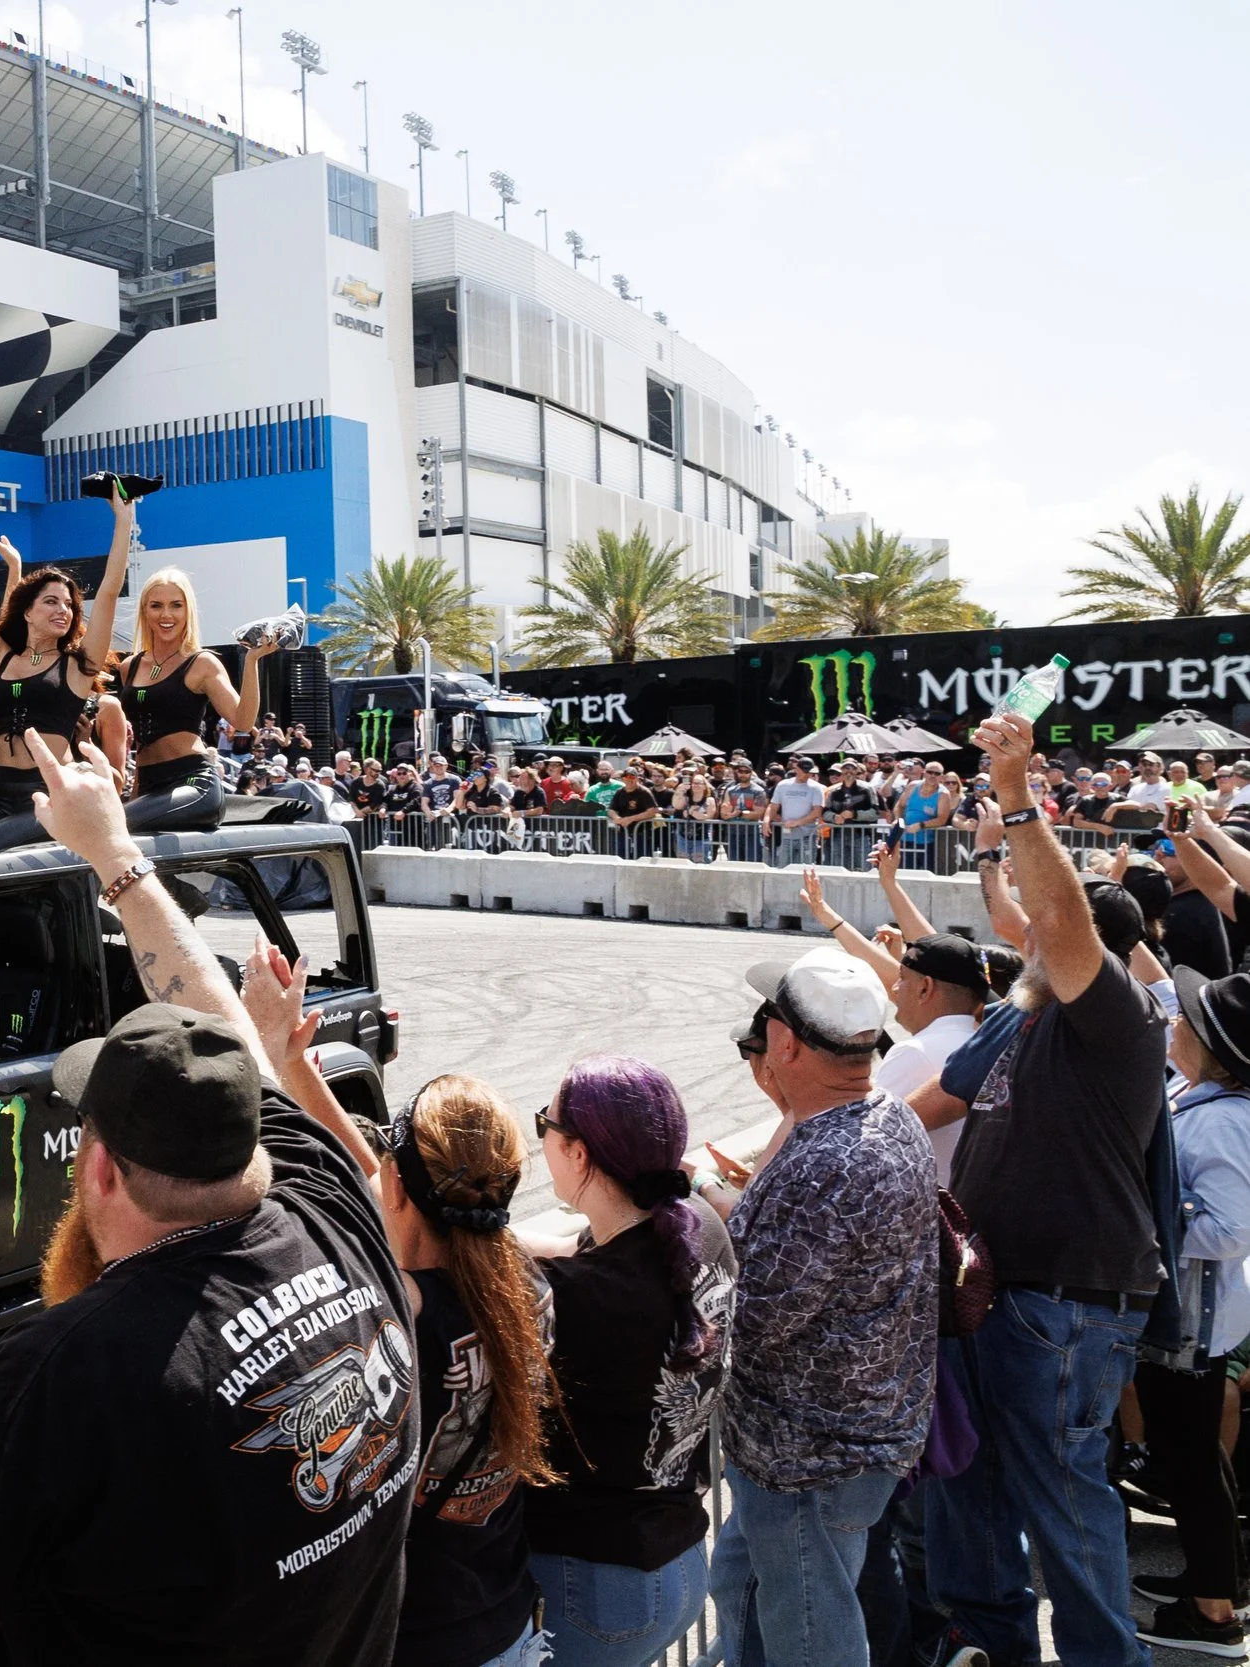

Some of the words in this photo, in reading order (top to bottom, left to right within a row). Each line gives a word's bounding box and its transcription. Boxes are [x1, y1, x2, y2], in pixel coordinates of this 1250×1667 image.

[334, 312, 384, 338] CHEVROLET
[220, 1263, 348, 1353] COLBOCK
[279, 1373, 363, 1488] Genuine
